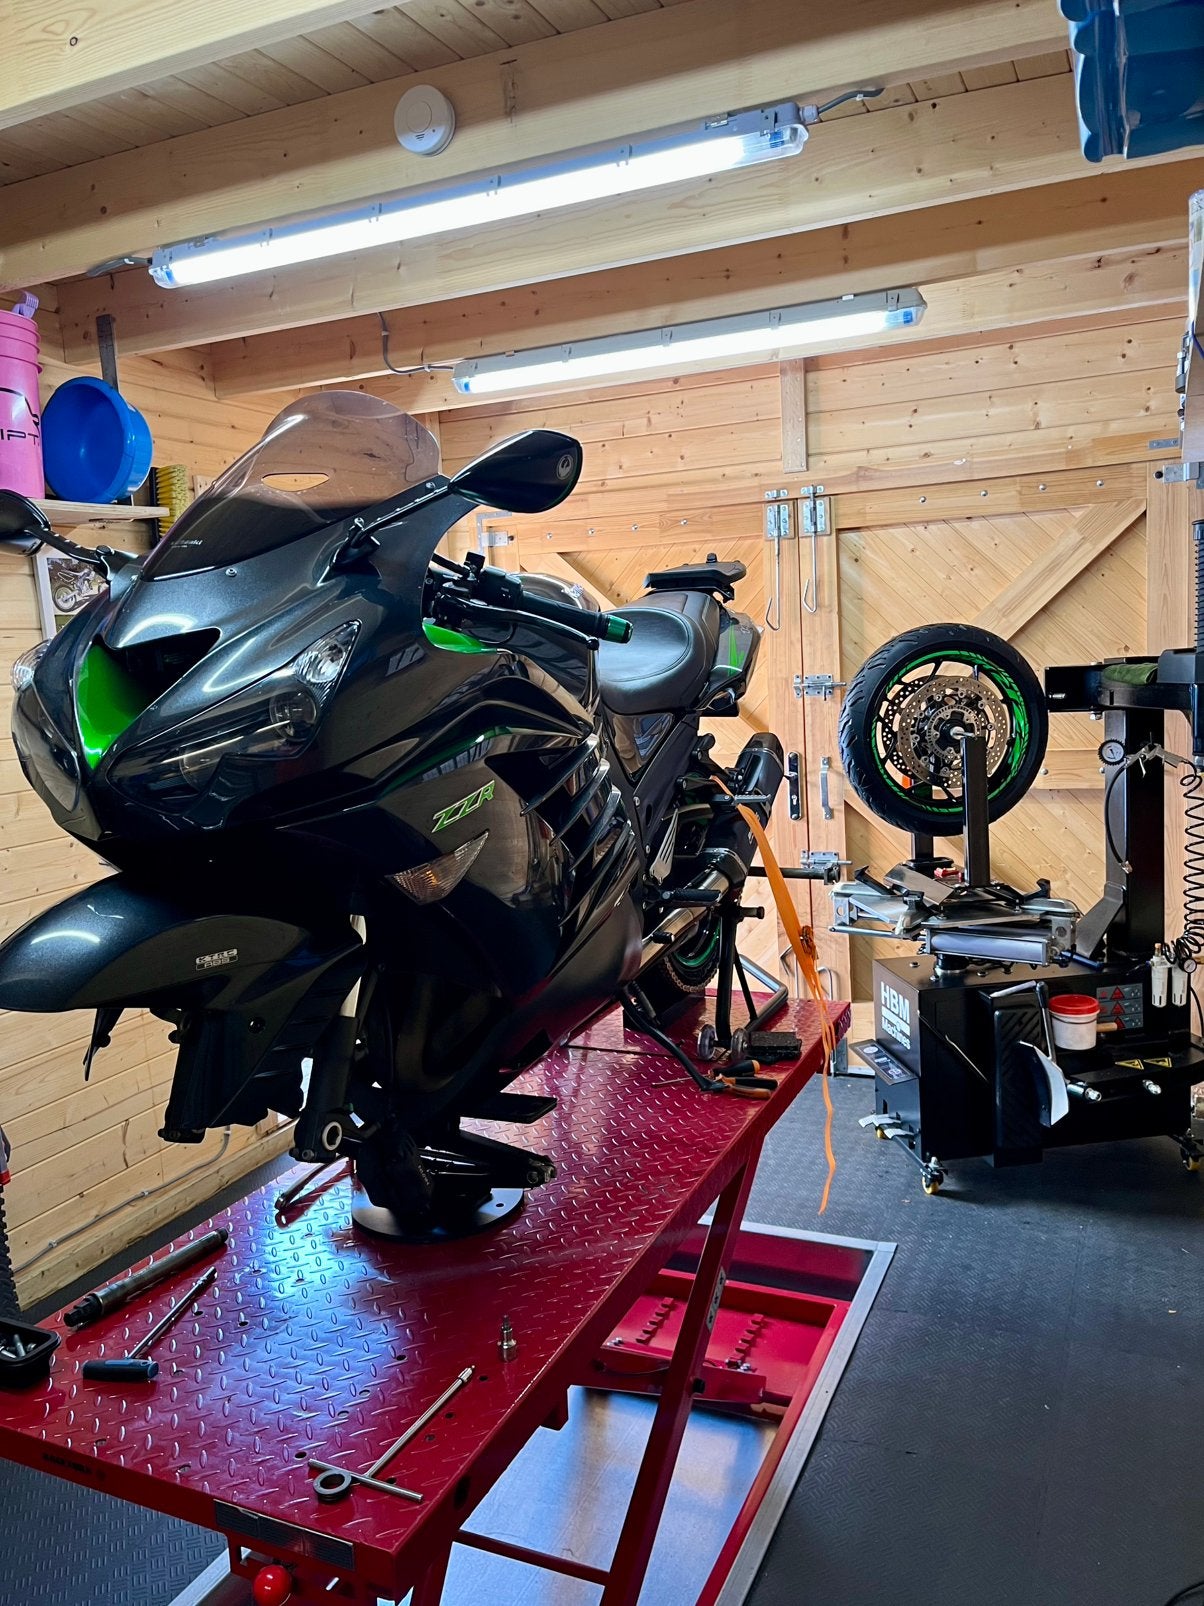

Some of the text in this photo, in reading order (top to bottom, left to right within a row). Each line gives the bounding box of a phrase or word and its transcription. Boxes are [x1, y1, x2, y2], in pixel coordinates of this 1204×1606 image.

[0, 429, 40, 446] IPT
[432, 780, 495, 833] ZZR
[881, 981, 910, 1024] HBM
[882, 1016, 911, 1050] Machines
